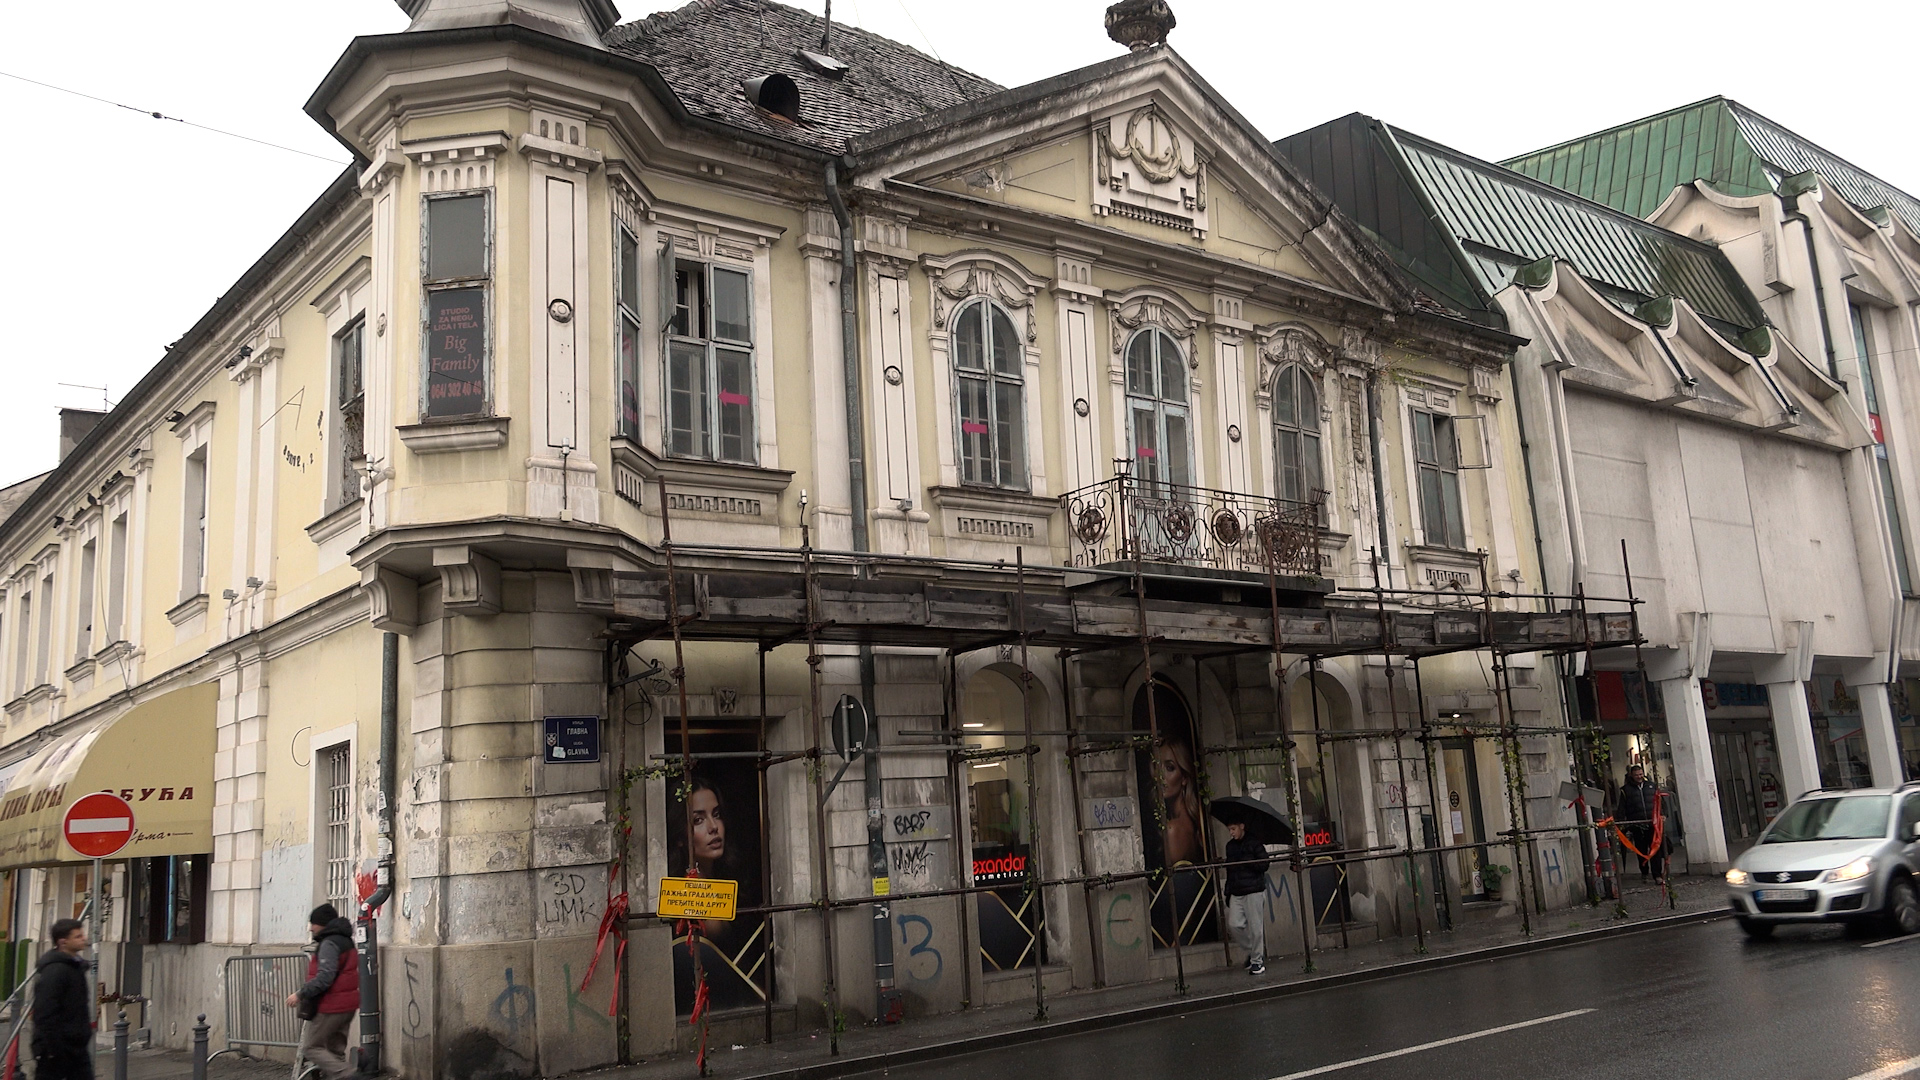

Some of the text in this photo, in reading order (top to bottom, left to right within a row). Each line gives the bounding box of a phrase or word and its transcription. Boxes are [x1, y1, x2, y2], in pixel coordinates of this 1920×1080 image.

[440, 307, 470, 315] STUDIO
[450, 314, 473, 322] NEGU
[433, 323, 451, 331] LICA
[458, 321, 478, 329] TELA
[444, 335, 467, 353] Big
[431, 353, 480, 373] Family
[100, 787, 194, 802] БУЋА
[667, 899, 694, 907] ПРЕЂИТЕ
